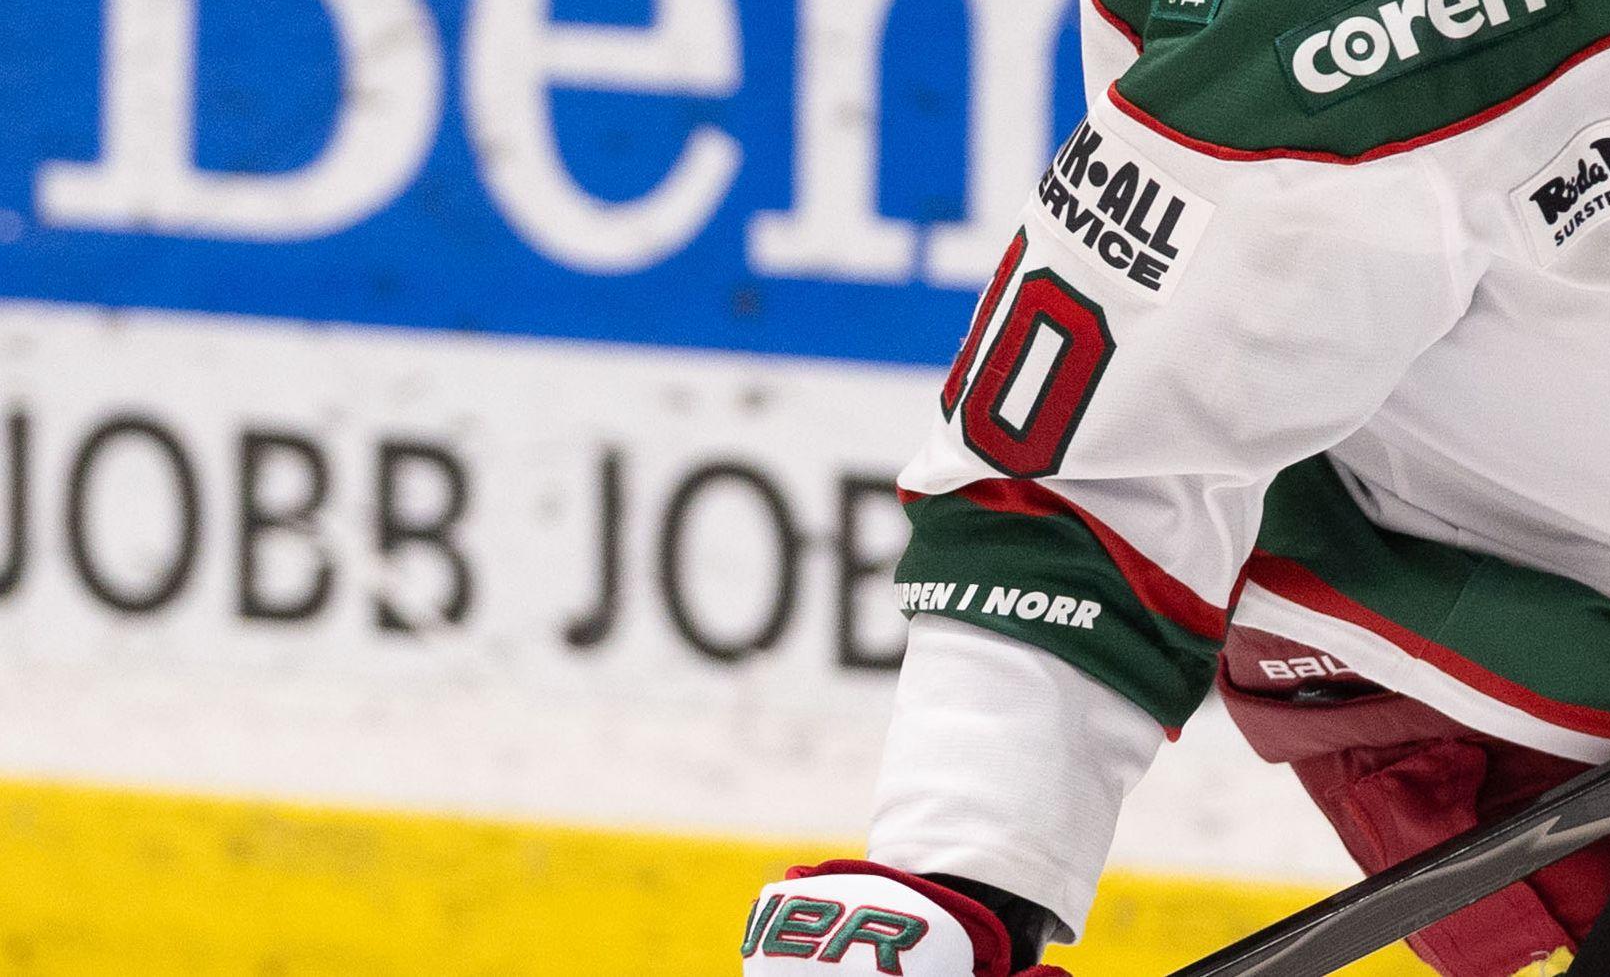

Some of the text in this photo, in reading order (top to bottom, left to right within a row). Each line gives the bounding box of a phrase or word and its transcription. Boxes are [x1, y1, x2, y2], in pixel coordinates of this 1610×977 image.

[566, 444, 906, 674] JOB
[957, 583, 979, 611] I
[981, 586, 1102, 630] NORR
